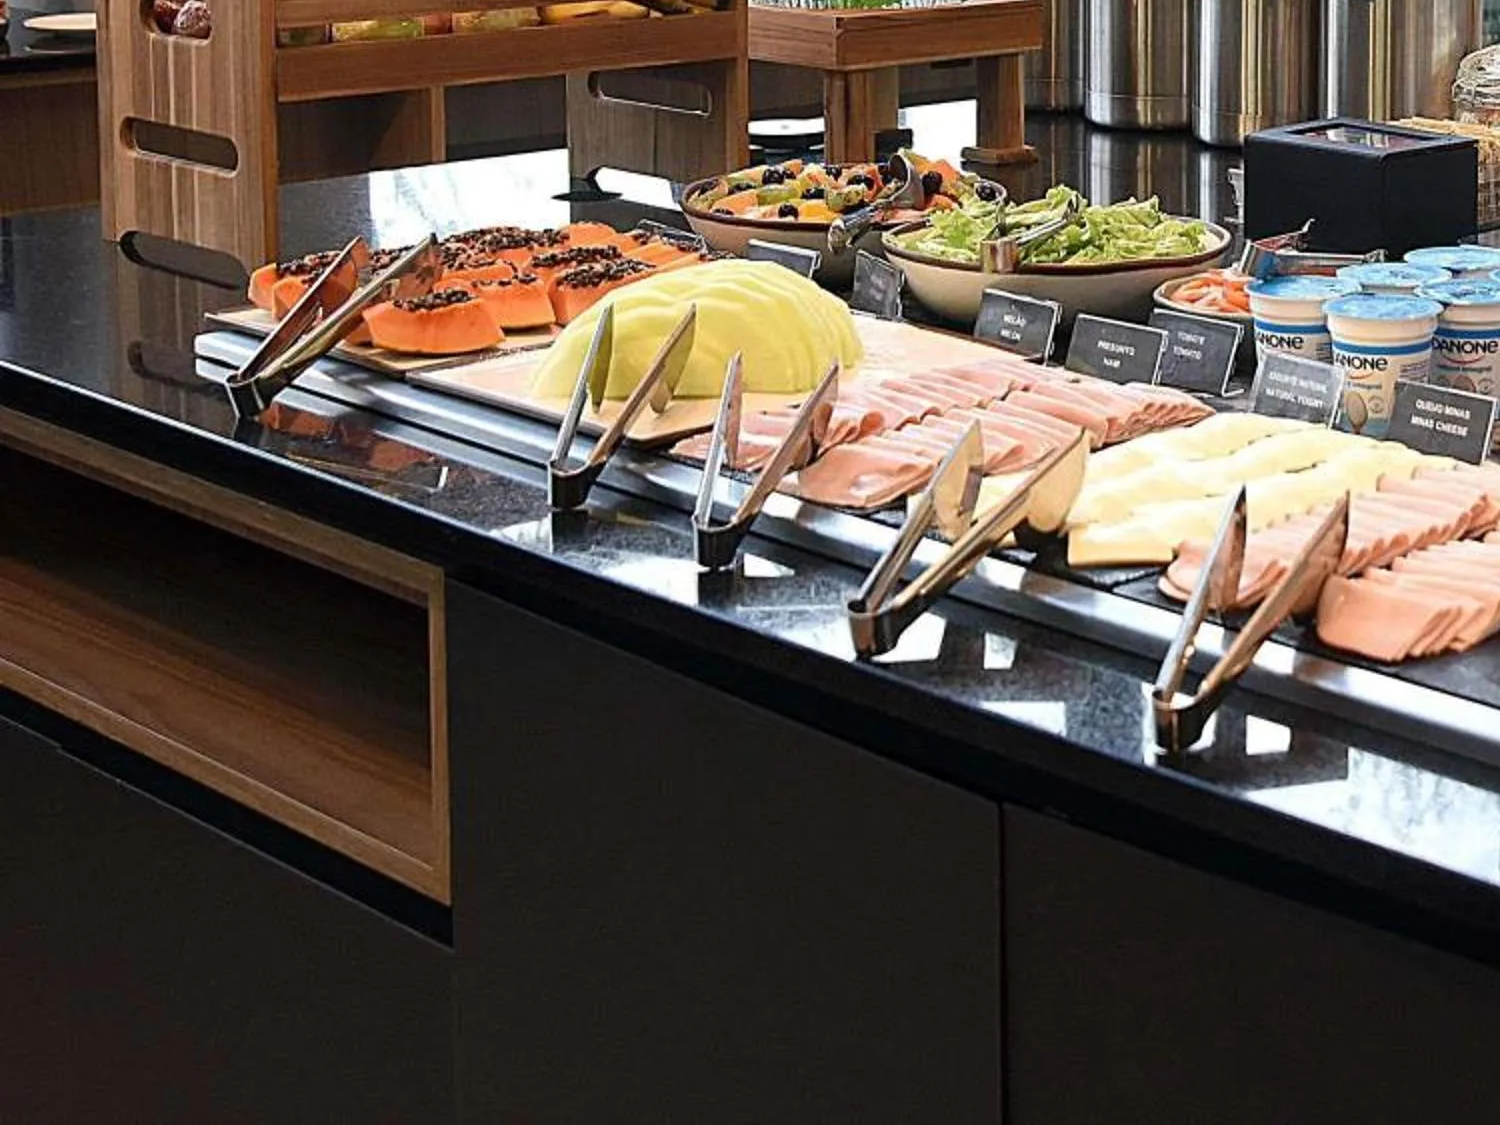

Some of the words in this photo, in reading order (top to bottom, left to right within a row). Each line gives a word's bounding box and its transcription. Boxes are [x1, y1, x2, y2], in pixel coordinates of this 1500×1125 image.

[1415, 399, 1444, 414] QUEIJO
[1444, 405, 1471, 420] MINAS
[1411, 415, 1434, 429] MINAS
[1435, 421, 1469, 436] CHEESE
